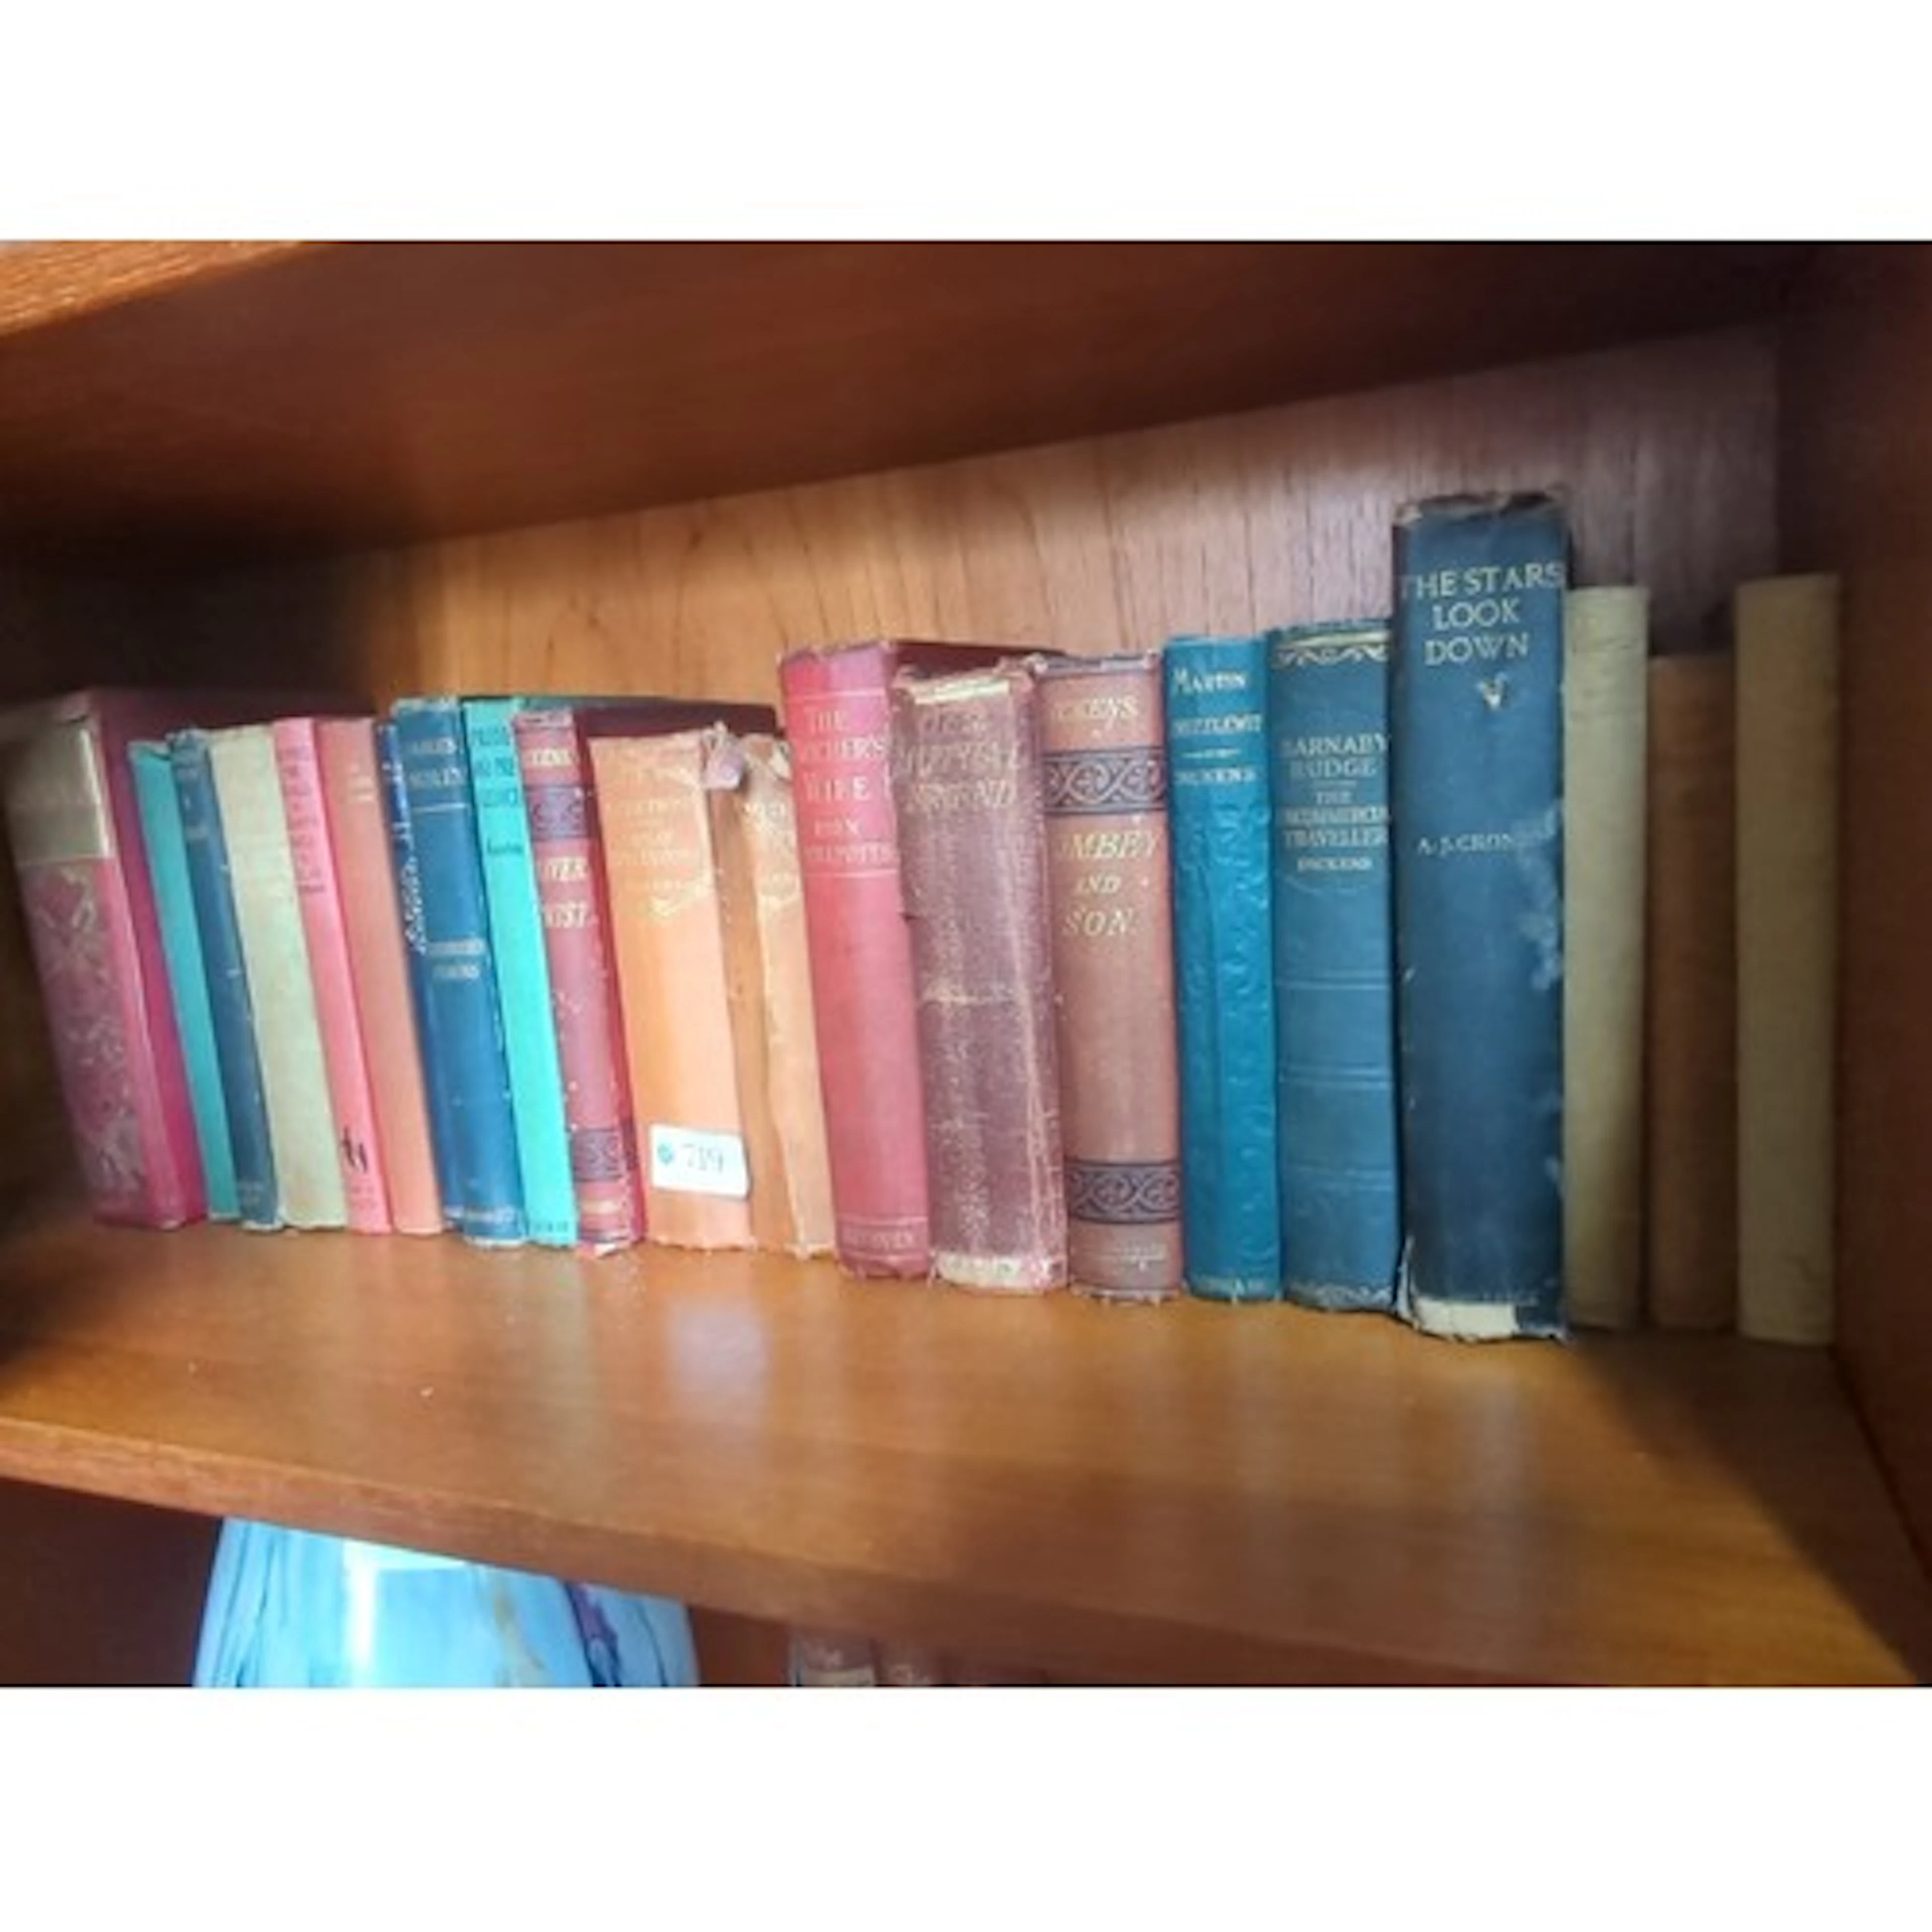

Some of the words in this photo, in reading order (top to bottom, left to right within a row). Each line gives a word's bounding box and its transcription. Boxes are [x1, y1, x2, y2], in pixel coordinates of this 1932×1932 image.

[1402, 570, 1457, 599] THE
[1464, 561, 1565, 597] STARS
[1432, 597, 1521, 631] LOOK
[1424, 632, 1529, 666] DOWN
[1290, 757, 1378, 780] RUDGE
[1060, 829, 1158, 858] MBEY
[1063, 906, 1137, 938] SON
